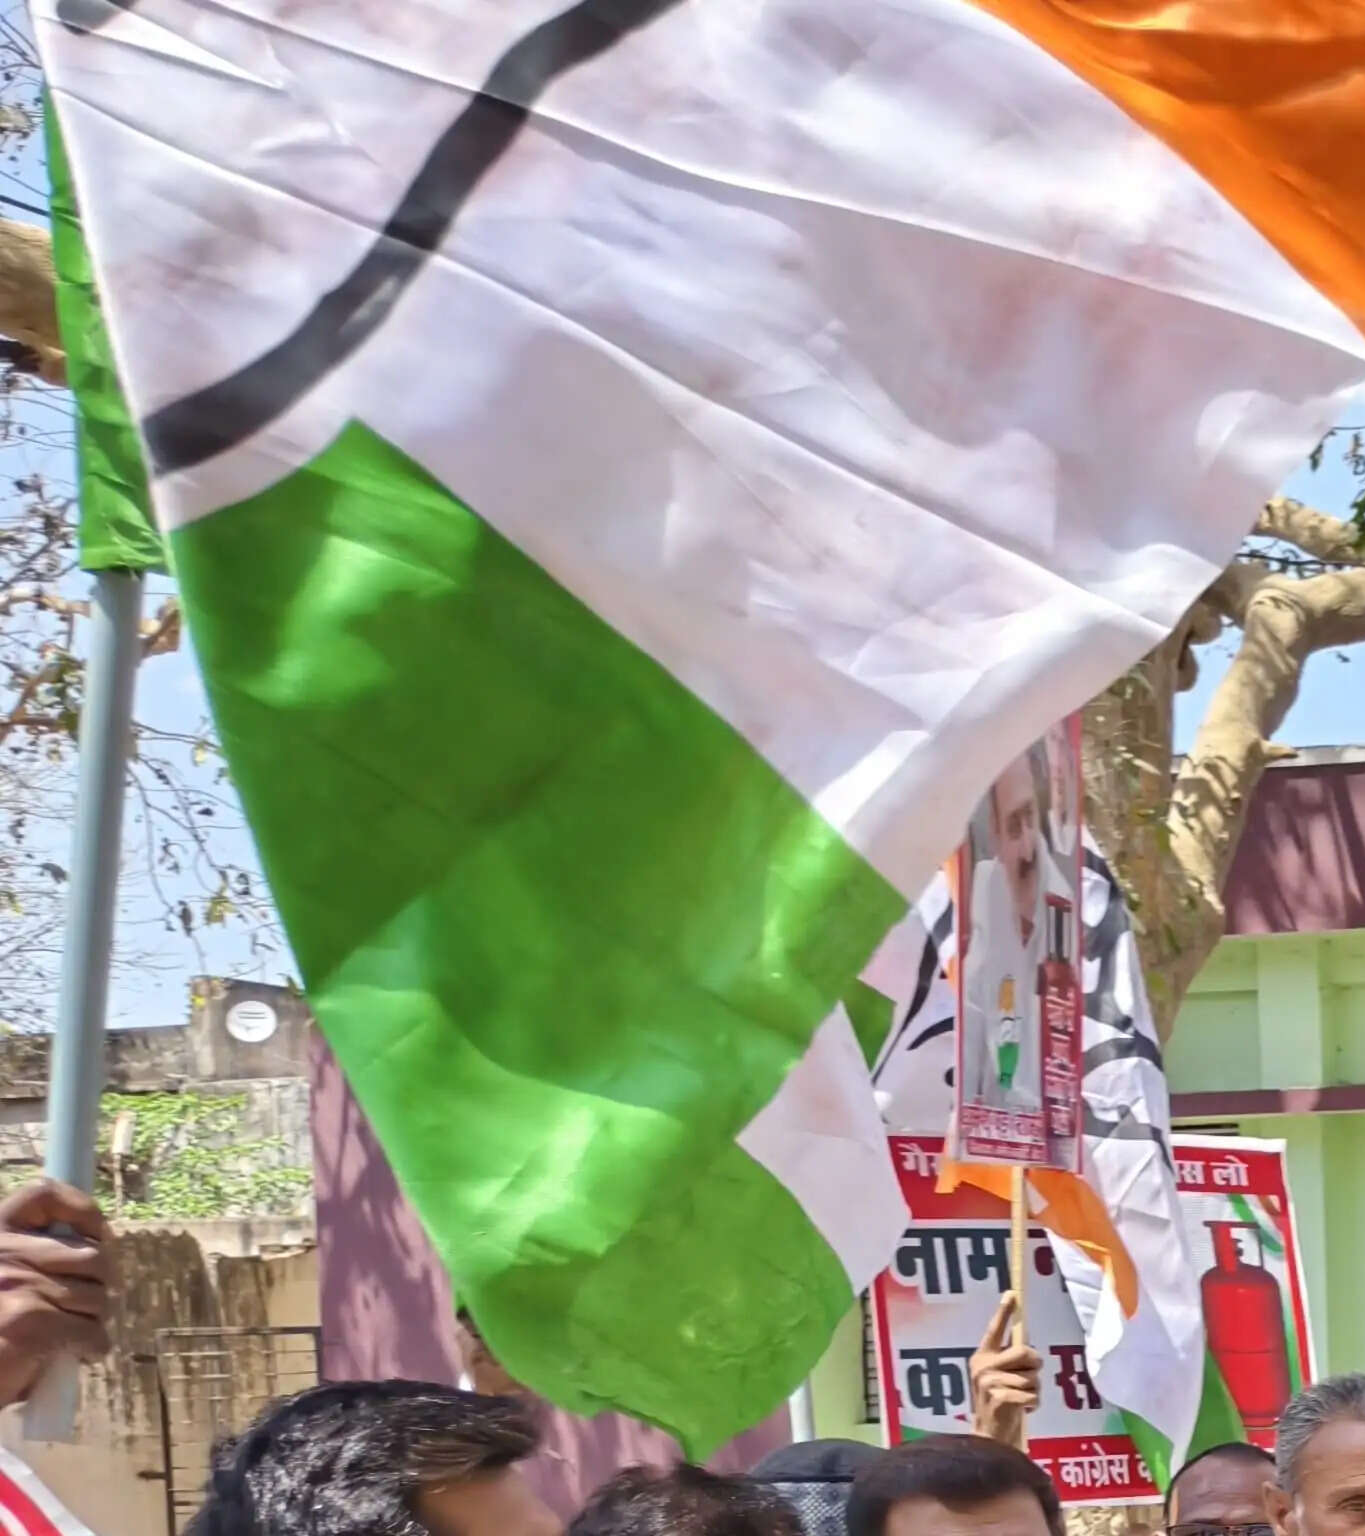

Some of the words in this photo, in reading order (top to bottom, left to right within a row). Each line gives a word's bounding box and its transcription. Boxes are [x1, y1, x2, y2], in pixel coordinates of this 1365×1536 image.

[1211, 1158, 1249, 1189] लो
[896, 1228, 1011, 1294] नाम
[1060, 1441, 1130, 1489] कांग्रेस
